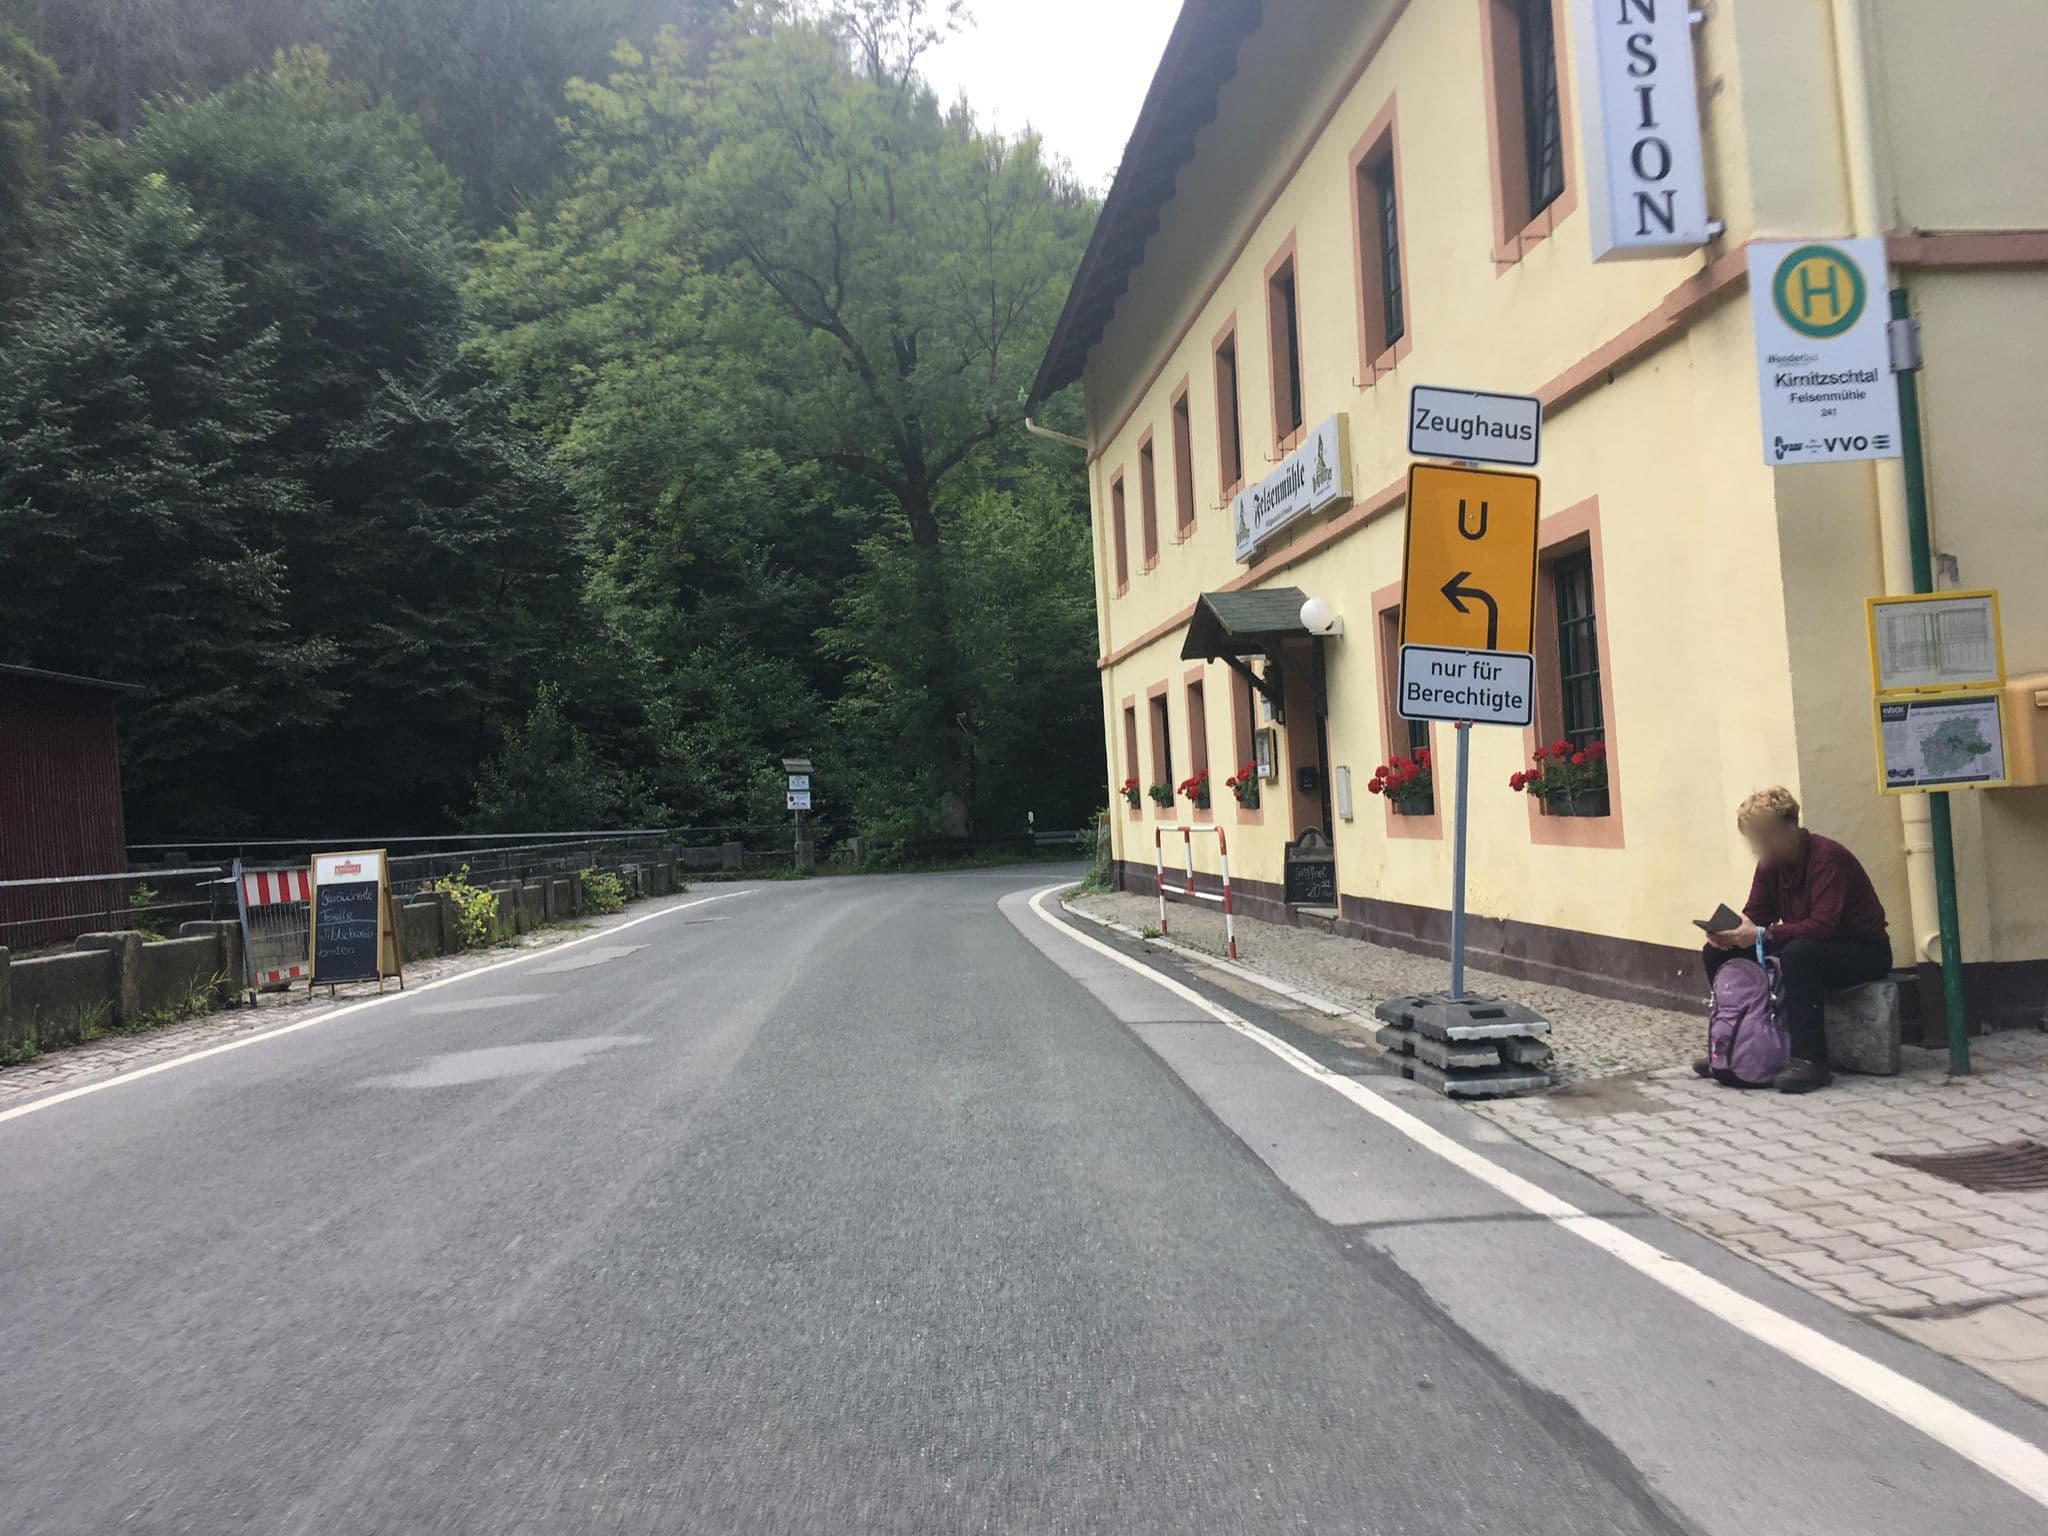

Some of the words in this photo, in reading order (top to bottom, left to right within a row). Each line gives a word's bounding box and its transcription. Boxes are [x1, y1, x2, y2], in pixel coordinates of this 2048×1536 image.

[1800, 265, 1840, 318] H
[1775, 368, 1879, 387] Kirnitzschtal
[1790, 389, 1867, 404] Felsenmühle
[1415, 408, 1533, 441] Zeughaus
[1823, 435, 1868, 453] VVO
[1458, 499, 1489, 540] U
[1431, 660, 1467, 679] nur
[1472, 660, 1503, 682] für
[1407, 682, 1523, 712] Berechtigte
